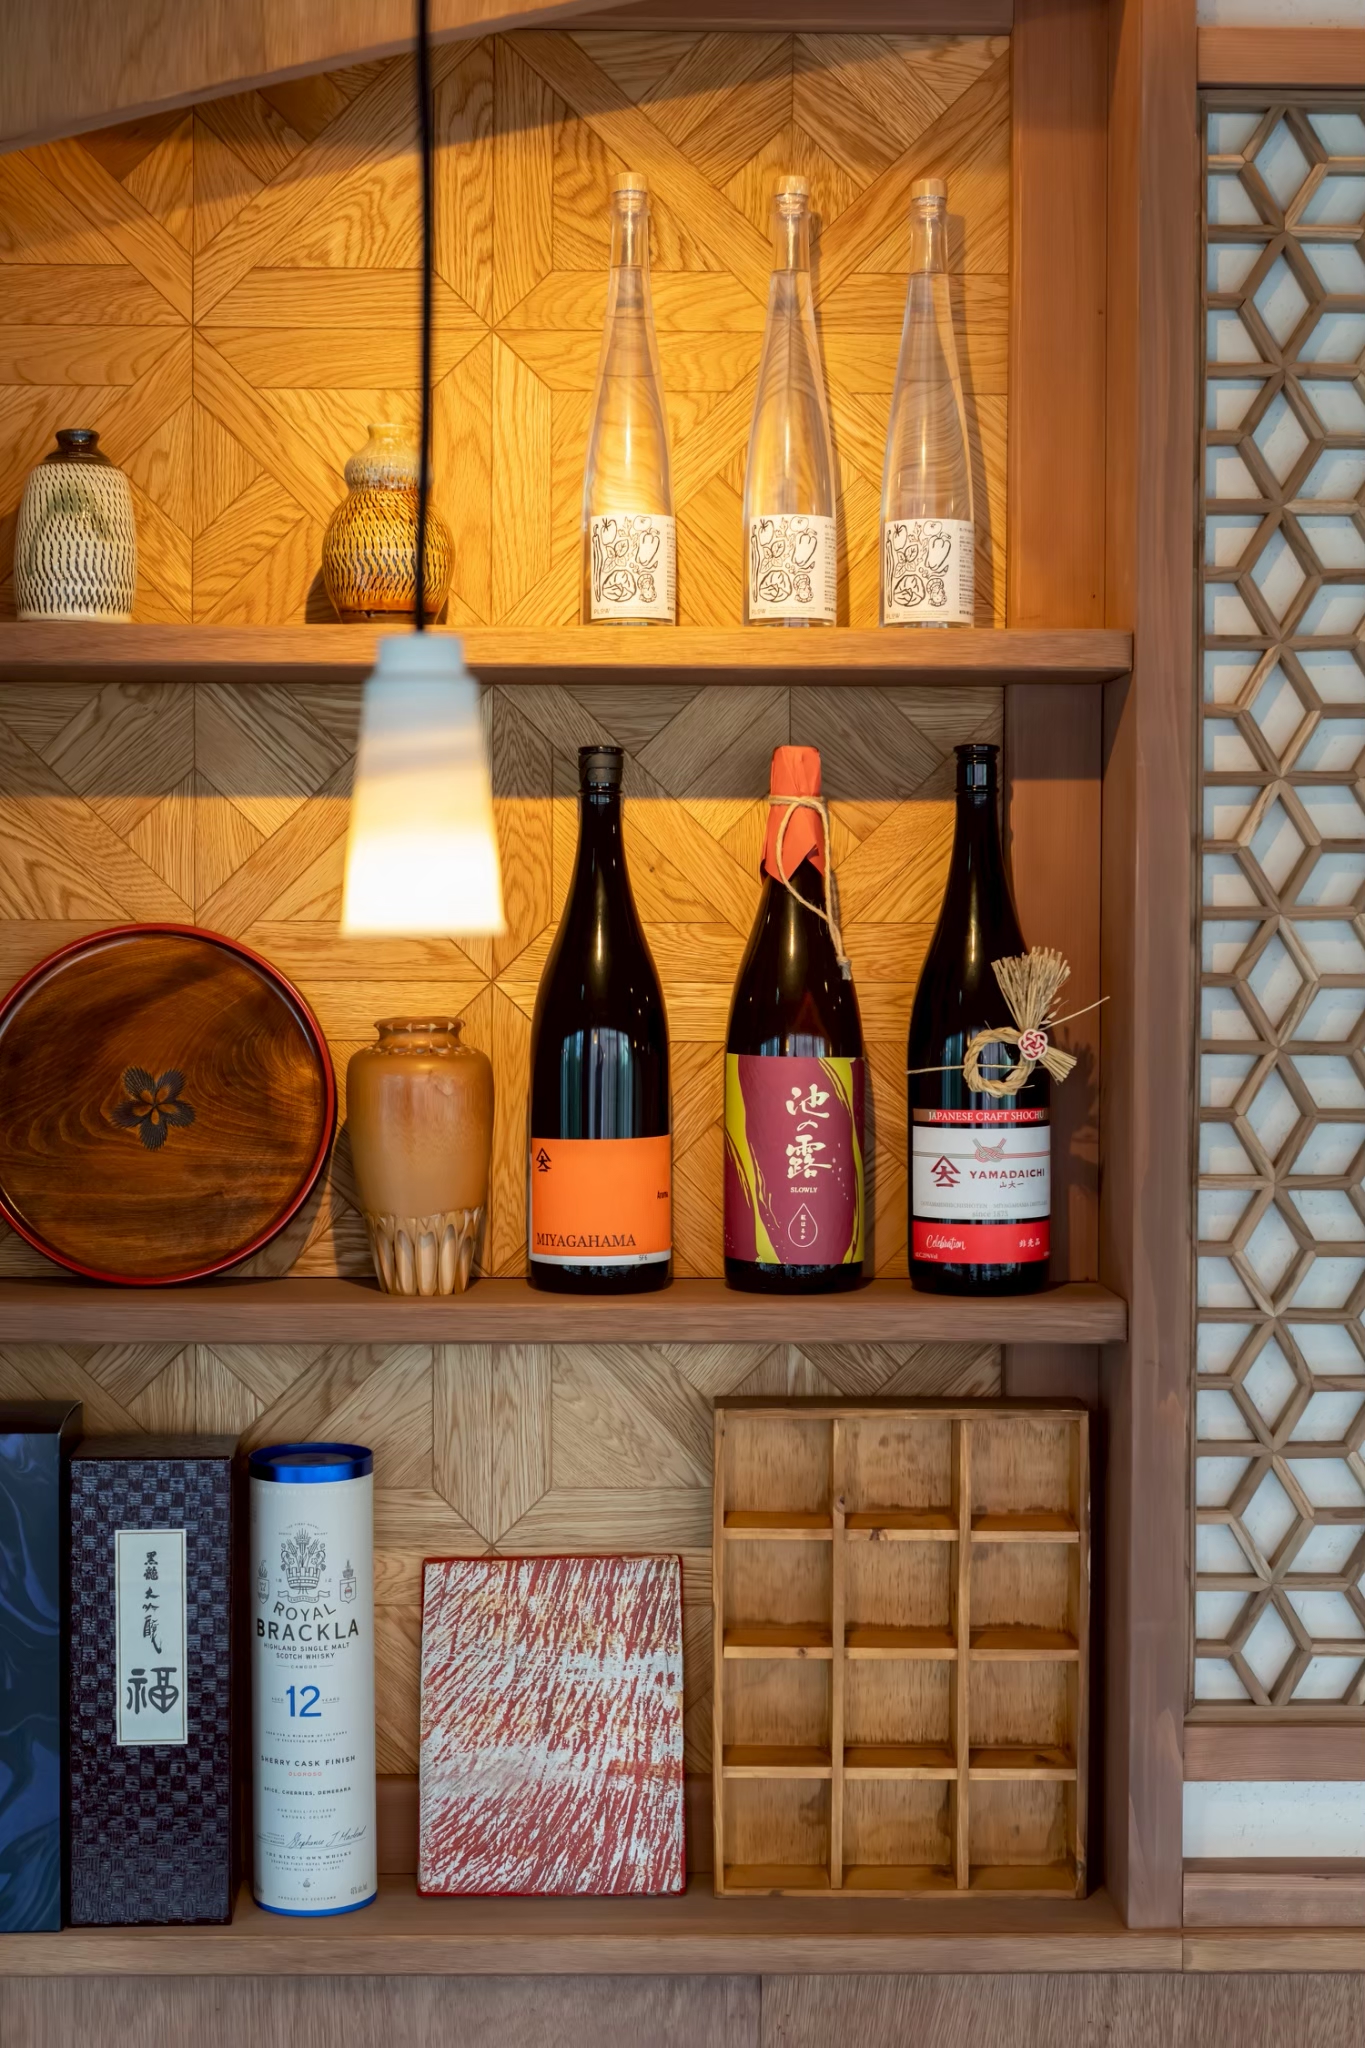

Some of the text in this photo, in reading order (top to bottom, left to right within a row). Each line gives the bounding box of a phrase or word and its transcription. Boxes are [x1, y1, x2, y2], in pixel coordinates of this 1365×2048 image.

[928, 1110, 1044, 1121] JAPANESE CRAFT SHOCHU
[786, 1083, 832, 1179] 池の露
[969, 1169, 1045, 1180] YAMADAICHI
[790, 1186, 818, 1194] SLOWLY
[972, 1210, 991, 1218] since
[536, 1232, 637, 1248] MIYAGAHAMA
[925, 1234, 966, 1250] Celebration
[273, 1601, 336, 1622] ROYAL
[256, 1617, 359, 1642] BRACKLA
[263, 1641, 350, 1652] HIGHLAND SINGLE MALT
[276, 1652, 335, 1660] SCOTCH WHISKY
[286, 1685, 322, 1718] 12
[261, 1755, 291, 1766] SHERRY
[325, 1755, 356, 1766] FINISH
